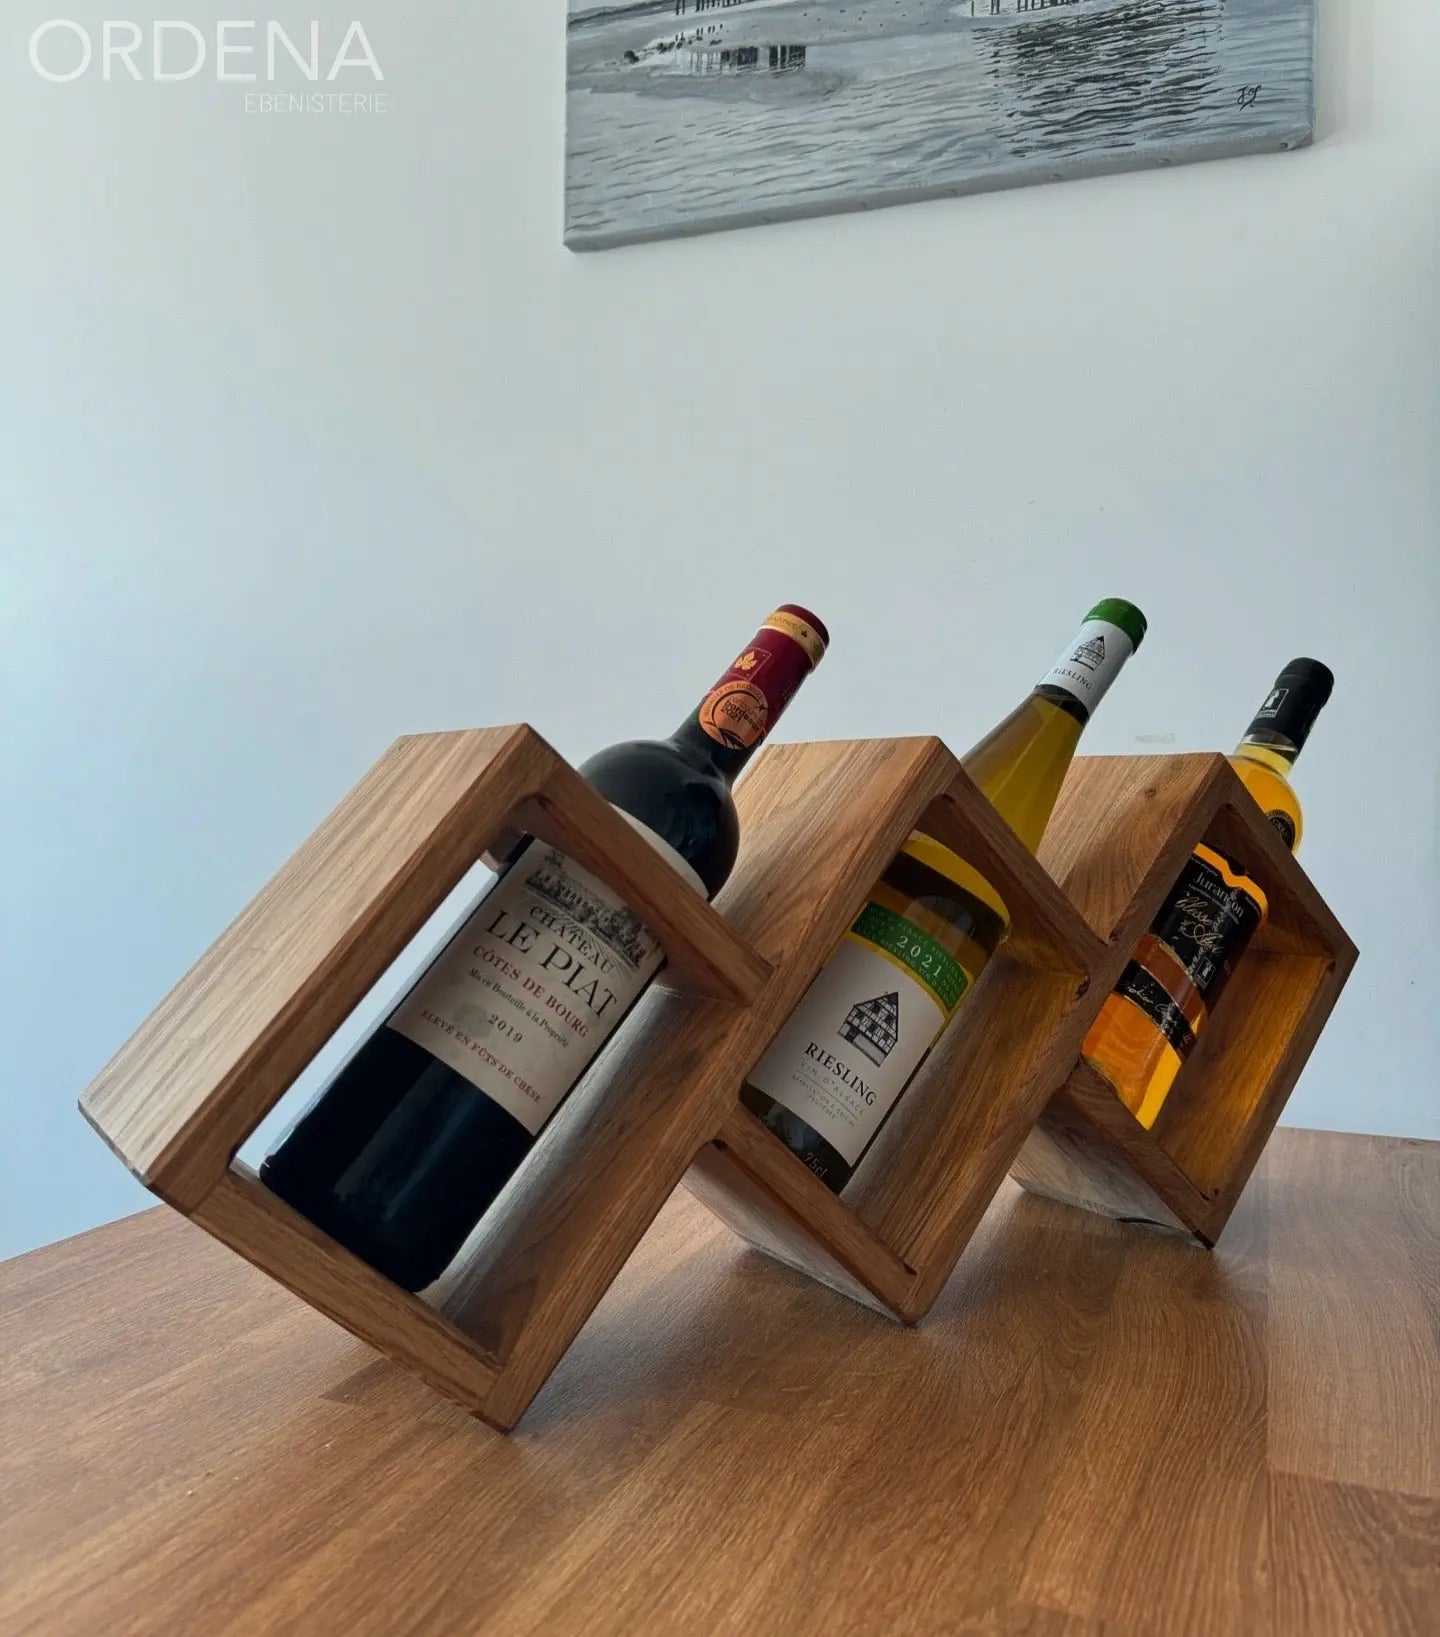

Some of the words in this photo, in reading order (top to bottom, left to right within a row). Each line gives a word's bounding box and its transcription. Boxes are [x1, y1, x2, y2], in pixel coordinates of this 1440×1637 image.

[1054, 668, 1092, 690] RIESLING
[484, 910, 540, 955] LE
[539, 942, 618, 1018] PIAT
[896, 934, 943, 978] 2021
[468, 967, 484, 982] Mis
[482, 977, 492, 988] en
[492, 982, 528, 1013] Bouteille
[531, 1011, 541, 1023] la
[522, 977, 545, 999] DE
[545, 994, 590, 1039] BOURG
[487, 1014, 524, 1045] 2019
[455, 1030, 470, 1046] EN
[498, 1062, 515, 1080] DE
[800, 1061, 820, 1078] VIN
[804, 1041, 878, 1107] RIESLING
[802, 1151, 828, 1178] 75cl
